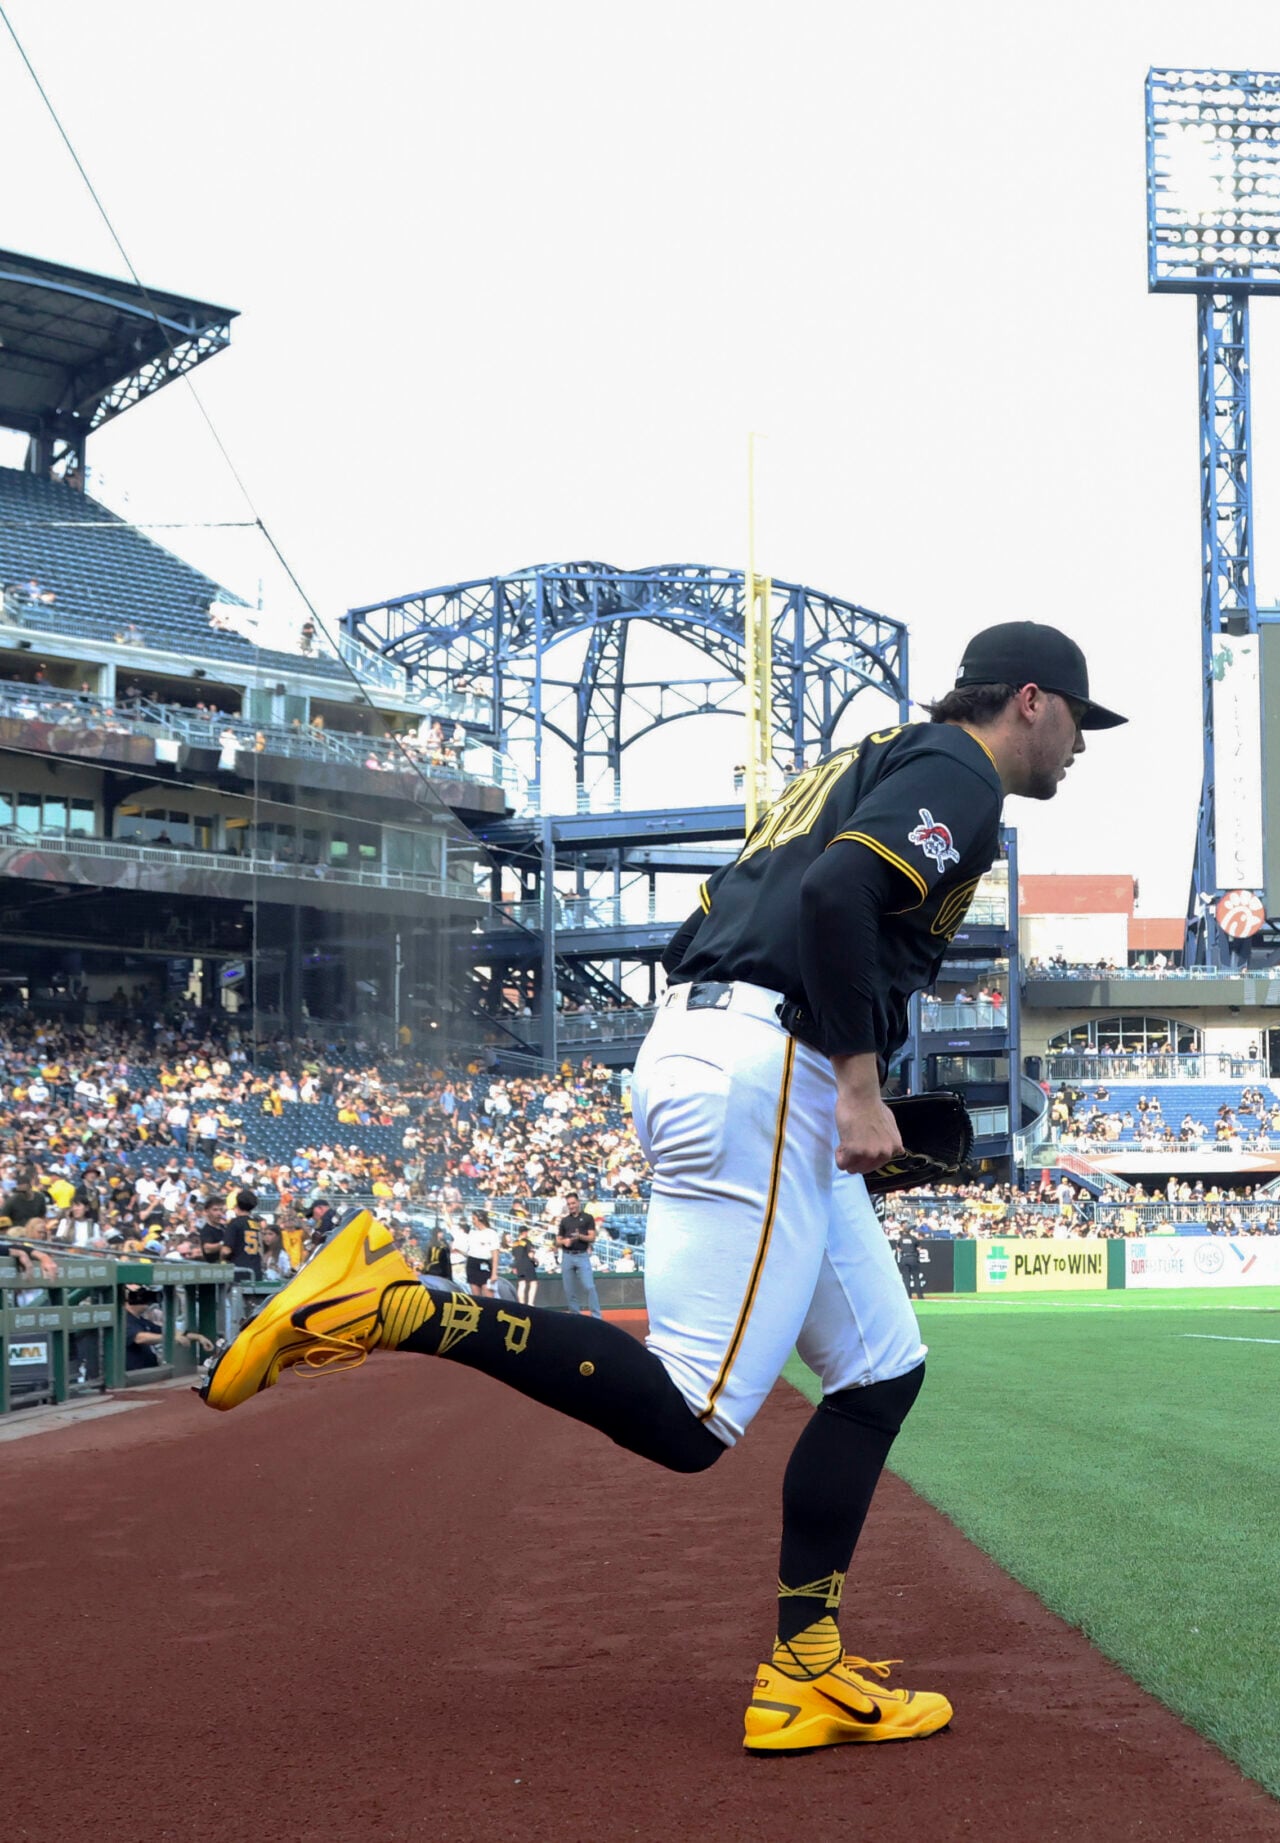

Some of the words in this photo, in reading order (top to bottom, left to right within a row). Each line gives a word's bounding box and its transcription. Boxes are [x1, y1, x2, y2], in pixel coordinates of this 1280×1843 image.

[1013, 1254, 1051, 1276] PLAY
[1053, 1258, 1067, 1272] TO
[1067, 1252, 1103, 1275] WIN!
[496, 1309, 532, 1354] P
